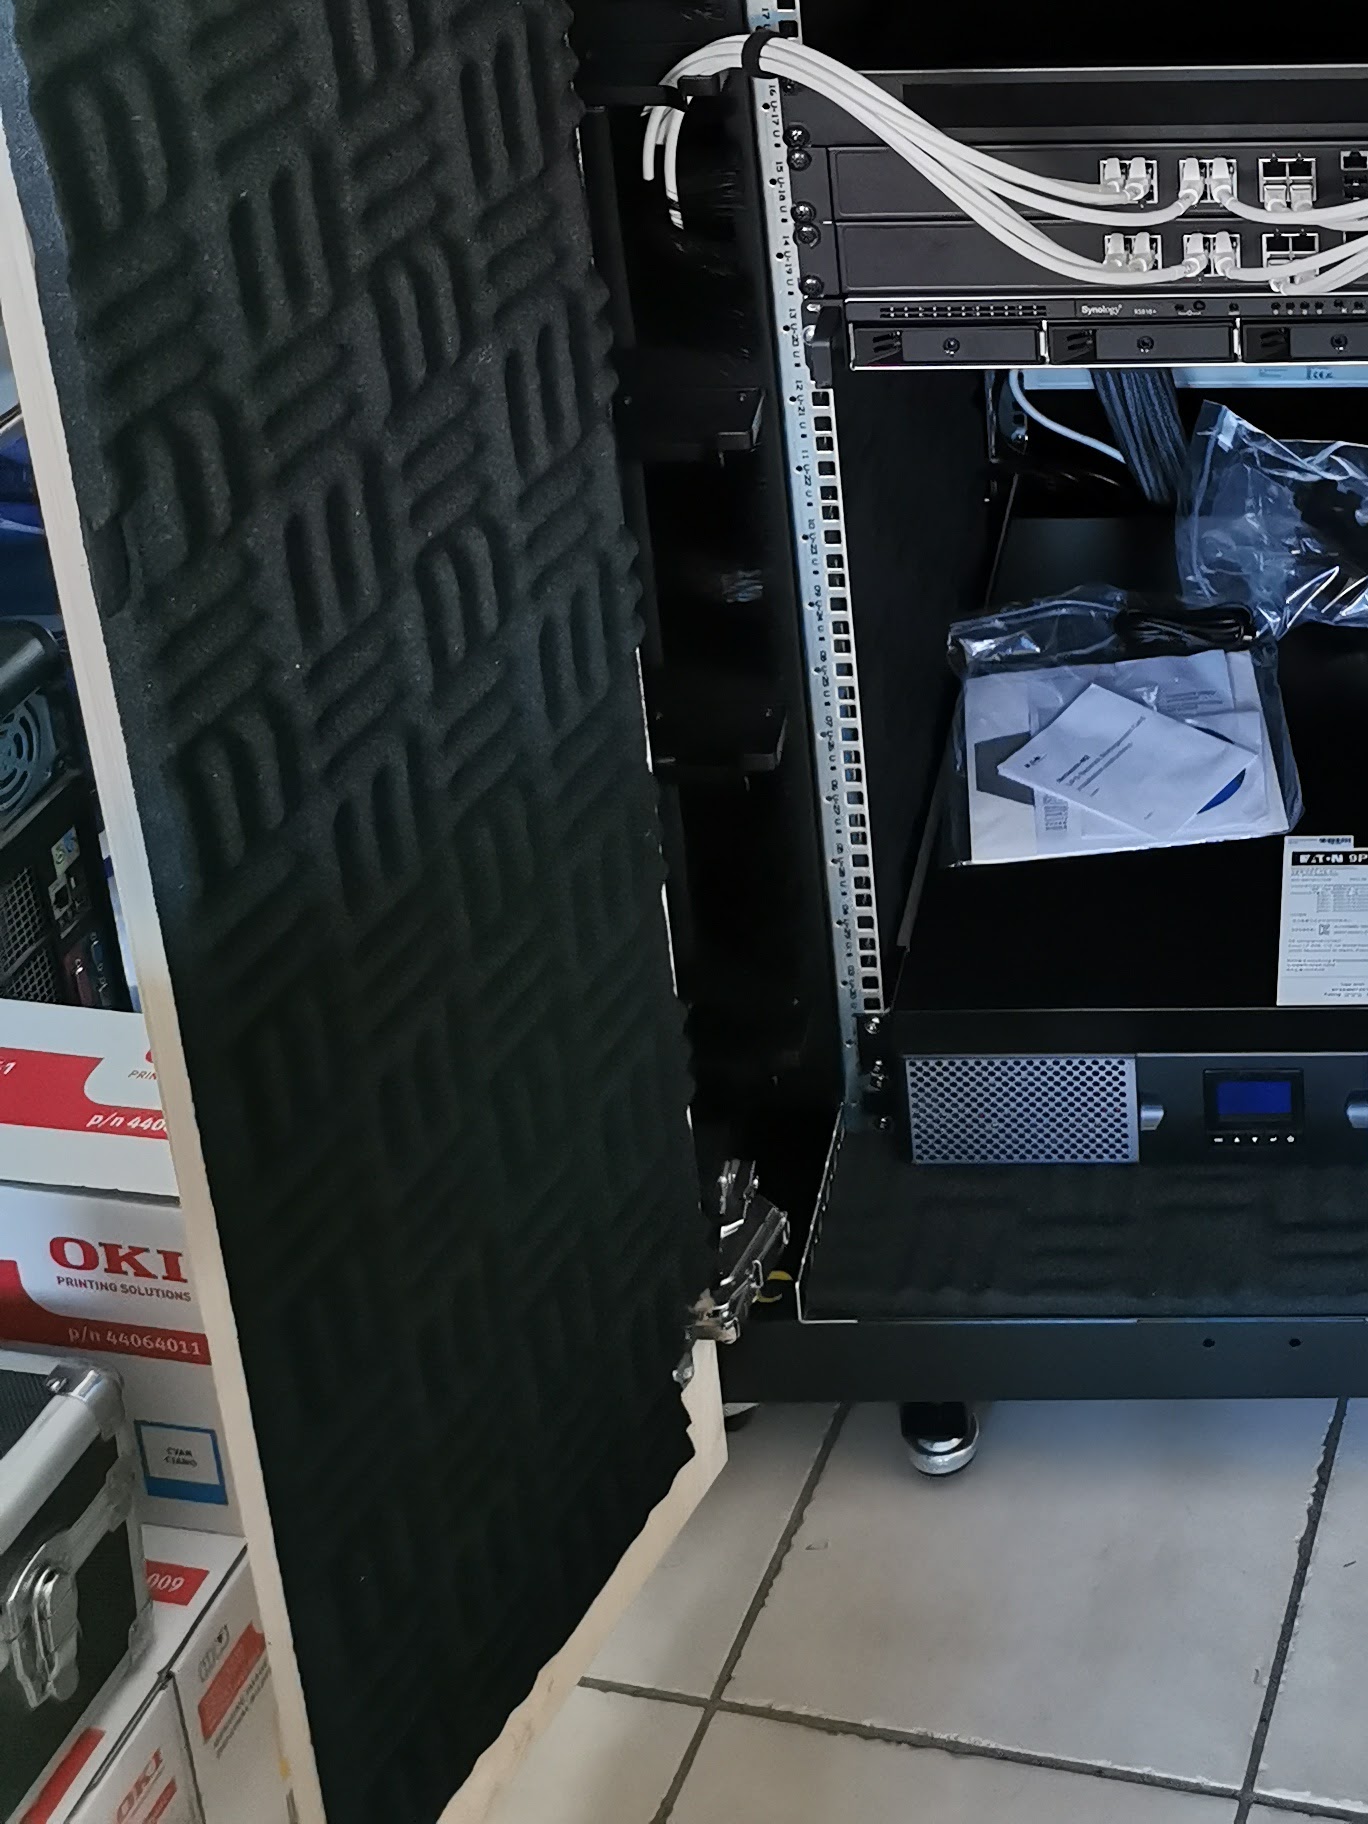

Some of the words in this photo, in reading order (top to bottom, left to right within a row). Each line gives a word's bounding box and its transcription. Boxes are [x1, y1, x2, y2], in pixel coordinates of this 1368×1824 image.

[86, 1112, 124, 1128] p/n
[49, 1236, 188, 1283] OKI
[56, 1275, 118, 1293] PRINTING
[120, 1283, 192, 1302] SOLUTIONS
[68, 1326, 100, 1343] p/n
[106, 1330, 201, 1356] 44064011
